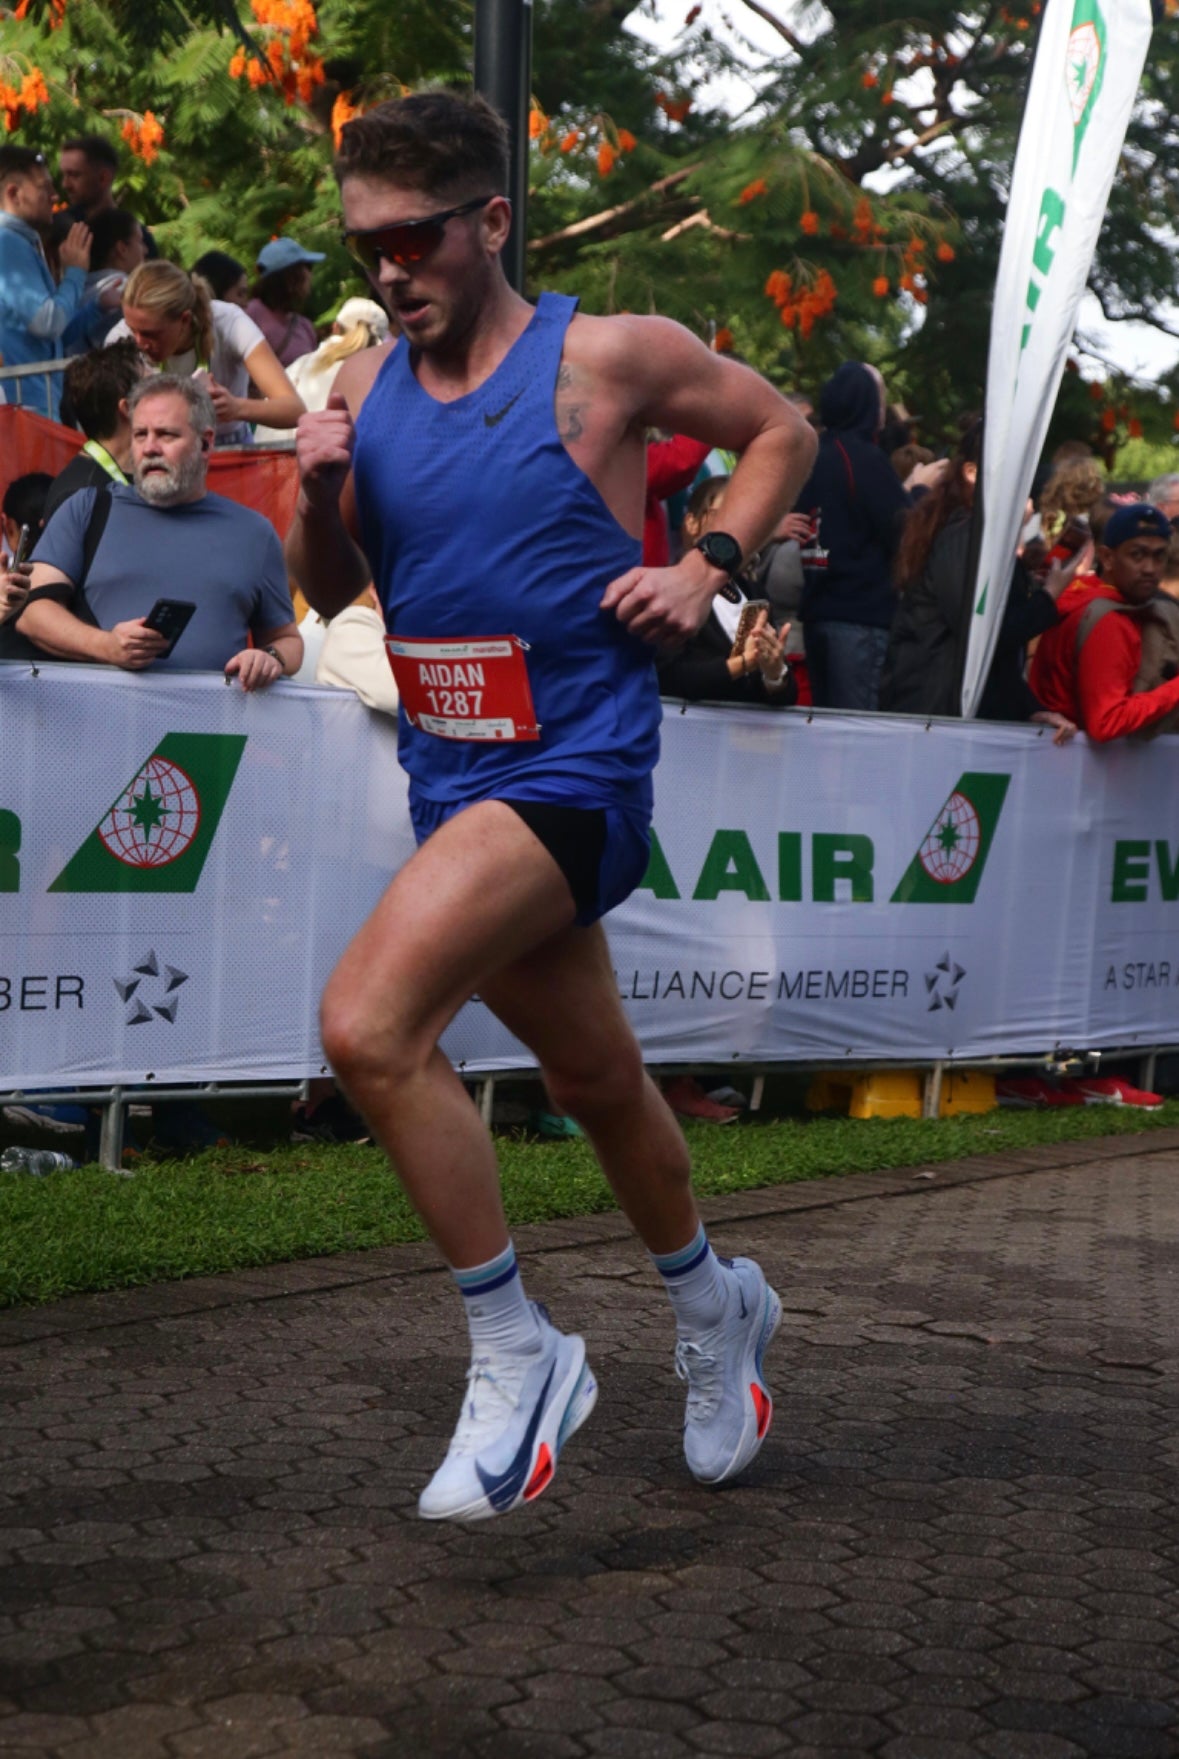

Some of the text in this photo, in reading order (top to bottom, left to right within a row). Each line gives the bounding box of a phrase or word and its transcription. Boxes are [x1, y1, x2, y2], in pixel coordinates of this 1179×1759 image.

[419, 664, 485, 687] AIDAN
[427, 690, 482, 715] 1287
[777, 969, 910, 1000] MEMBER
[1104, 961, 1170, 990] A STAR
